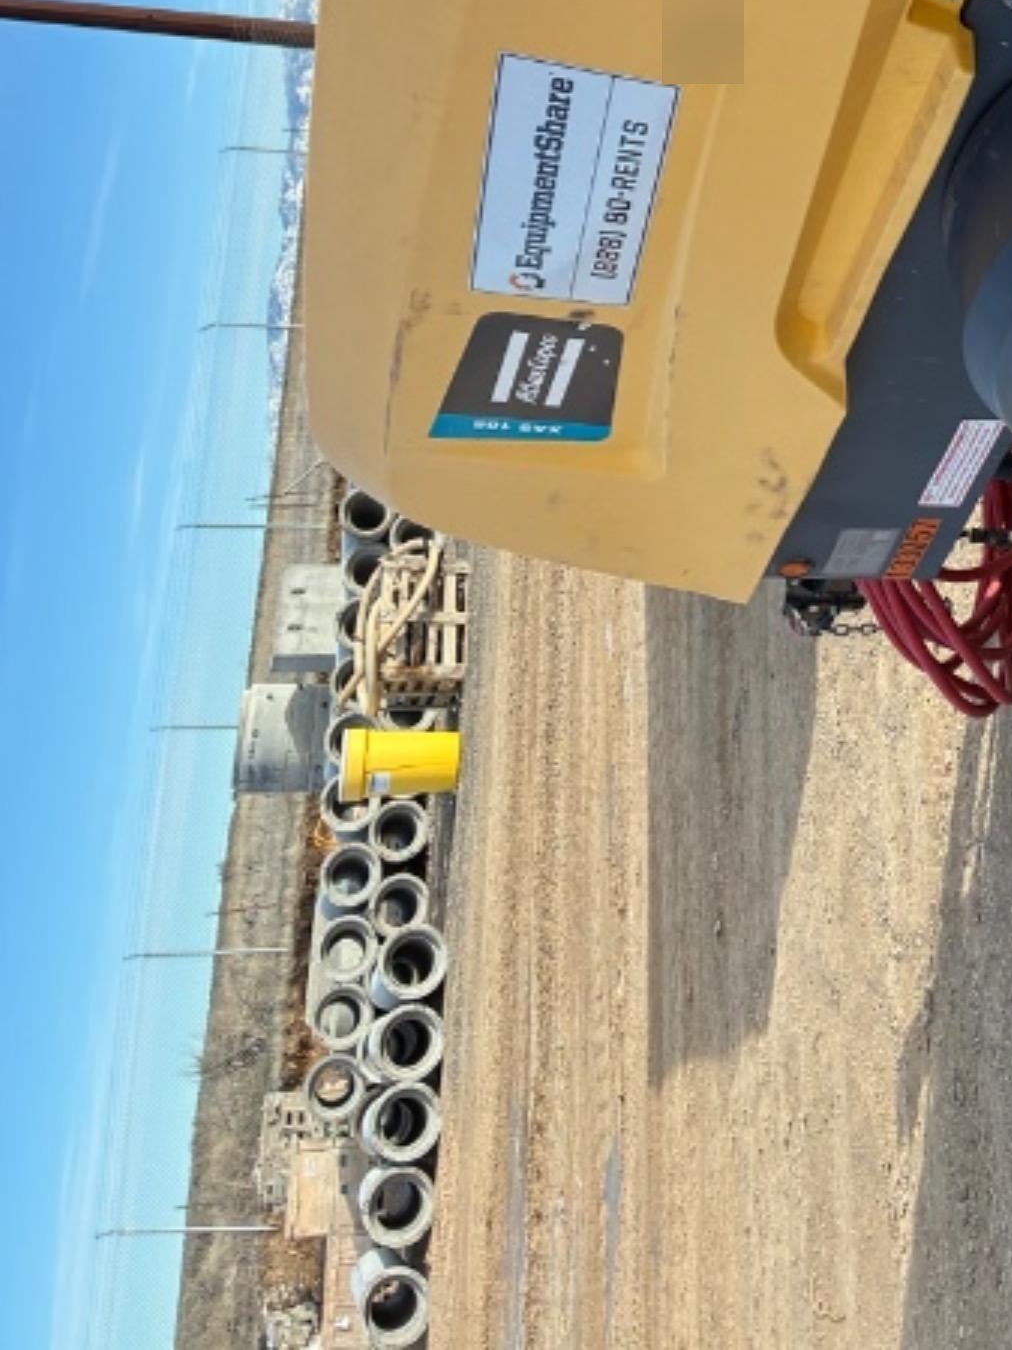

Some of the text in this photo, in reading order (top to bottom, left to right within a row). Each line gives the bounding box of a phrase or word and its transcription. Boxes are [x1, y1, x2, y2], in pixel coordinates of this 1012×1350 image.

[514, 77, 575, 270] EquipmentShare
[590, 119, 650, 280] (888) 80-RENTS
